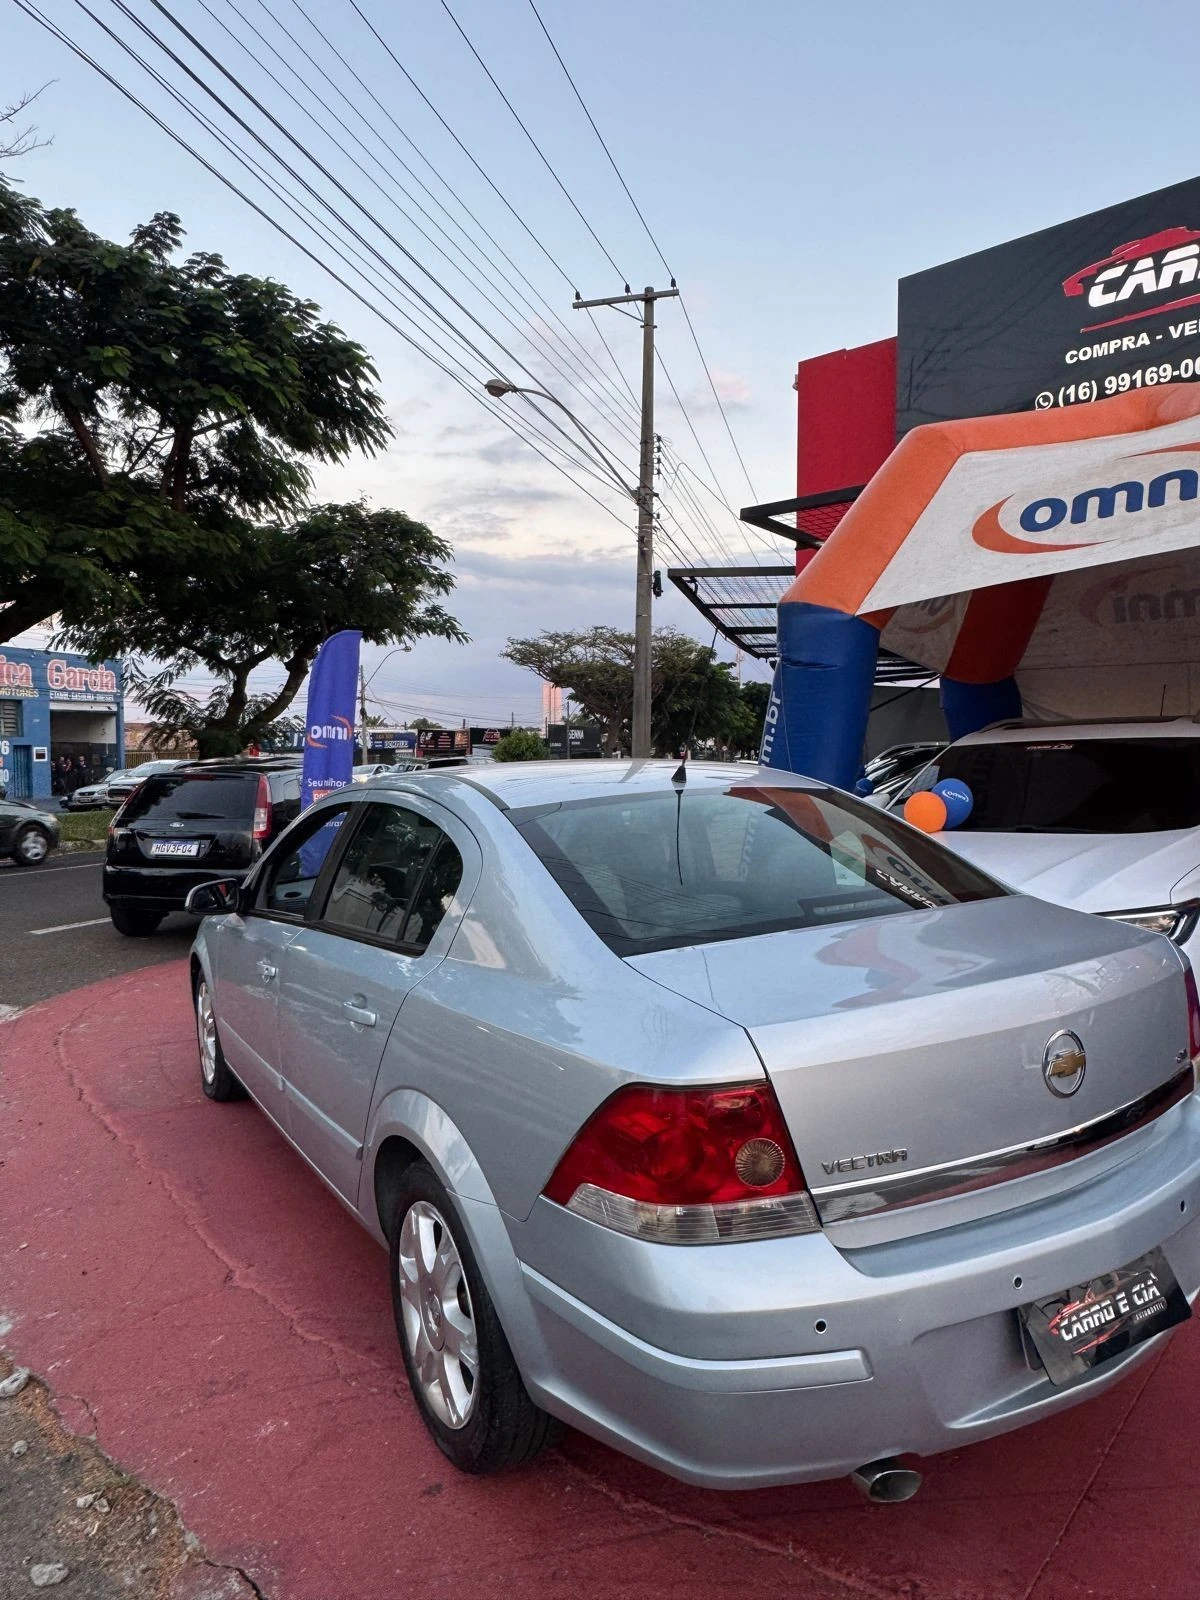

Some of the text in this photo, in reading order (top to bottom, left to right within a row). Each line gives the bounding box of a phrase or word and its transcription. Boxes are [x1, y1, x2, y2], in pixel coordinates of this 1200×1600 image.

[1088, 244, 1200, 308] CAR
[1065, 332, 1150, 364] COMPRA
[1168, 320, 1200, 339] VE
[1058, 380, 1098, 407] (16)
[48, 660, 117, 693] Garcia
[308, 778, 323, 787] Seu
[821, 1148, 907, 1175] VECTRA
[1116, 1291, 1130, 1314] E
